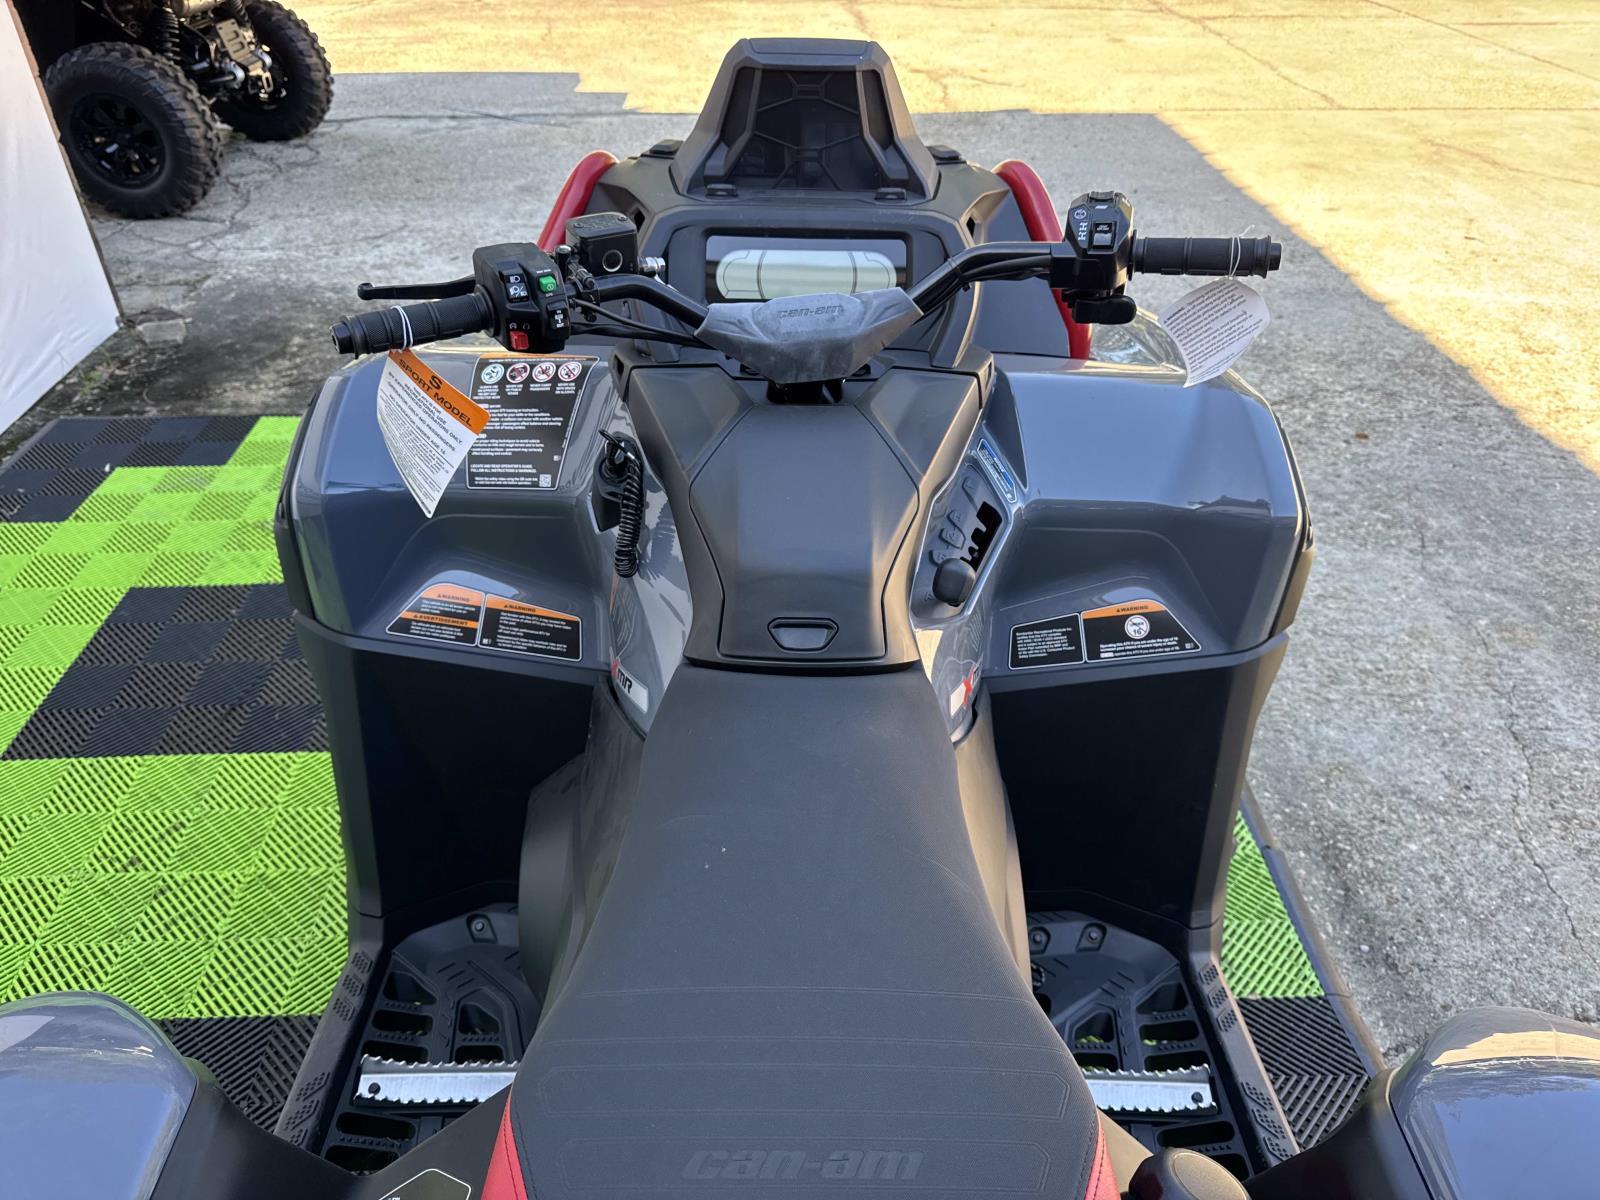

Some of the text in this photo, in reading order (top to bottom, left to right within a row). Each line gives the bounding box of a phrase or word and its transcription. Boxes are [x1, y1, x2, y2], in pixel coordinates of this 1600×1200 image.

[399, 359, 472, 427] SPORT MODEL
[421, 407, 449, 433] OPERATORS
[435, 415, 446, 425] USE
[425, 423, 456, 451] PASSENGERS
